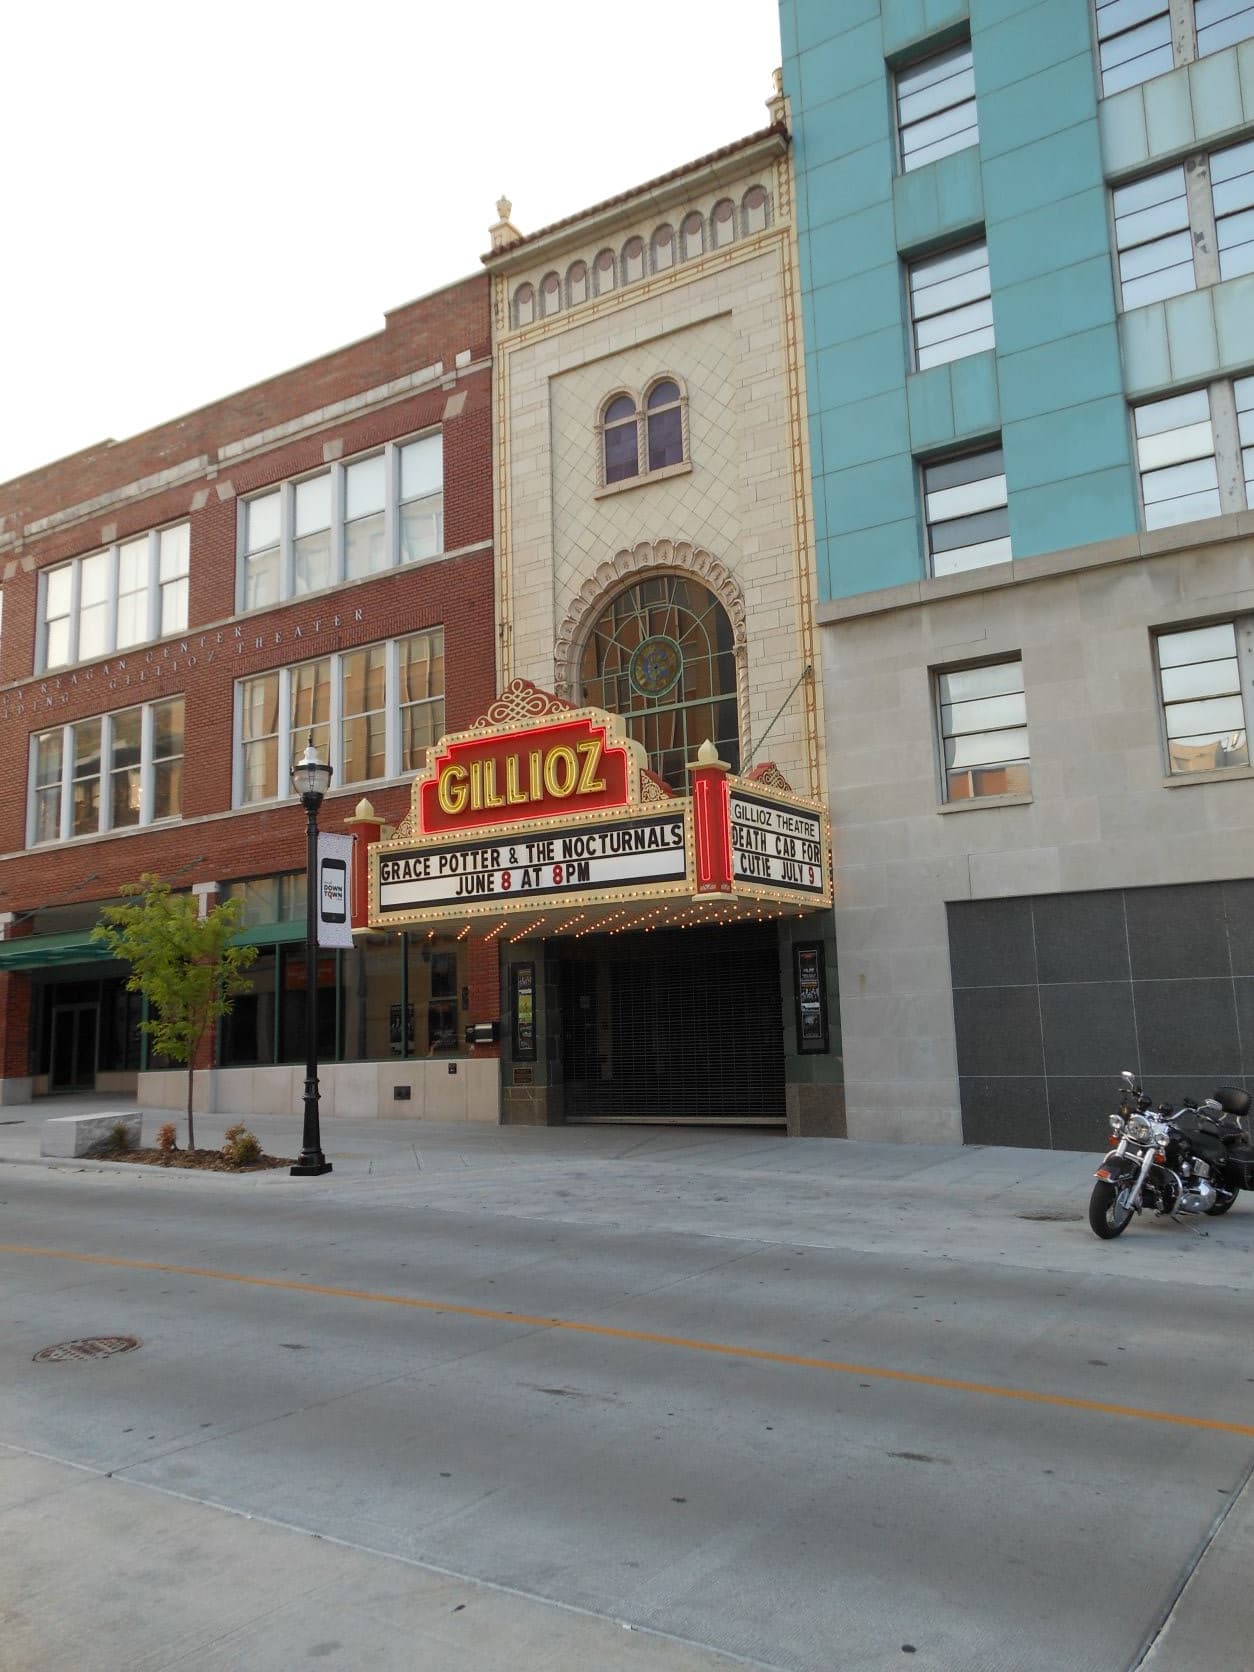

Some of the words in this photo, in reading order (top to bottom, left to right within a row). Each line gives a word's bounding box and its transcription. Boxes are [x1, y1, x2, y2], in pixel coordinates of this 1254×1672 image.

[145, 626, 242, 664] CENTER
[236, 607, 363, 654] THEATER
[438, 738, 607, 815] GILLIOZ
[734, 803, 772, 826] GILLIOZ
[776, 814, 815, 838] THEATRE
[381, 857, 431, 881] GRACE
[439, 848, 501, 874] POTTER
[509, 847, 519, 864] &
[526, 841, 555, 864] THE
[562, 824, 683, 860] NOCTURNALS
[732, 825, 767, 853] DEATH
[775, 835, 797, 858] CAB
[802, 841, 820, 863] FOR
[455, 873, 495, 896] JUNE
[501, 871, 512, 891] 8
[521, 867, 542, 889] AT
[552, 861, 590, 885] 8PM
[740, 853, 771, 878] CUTIE
[781, 861, 803, 883] JULY
[808, 865, 815, 885] 9
[323, 884, 343, 892] DOWN
[323, 890, 343, 900] TOWN
